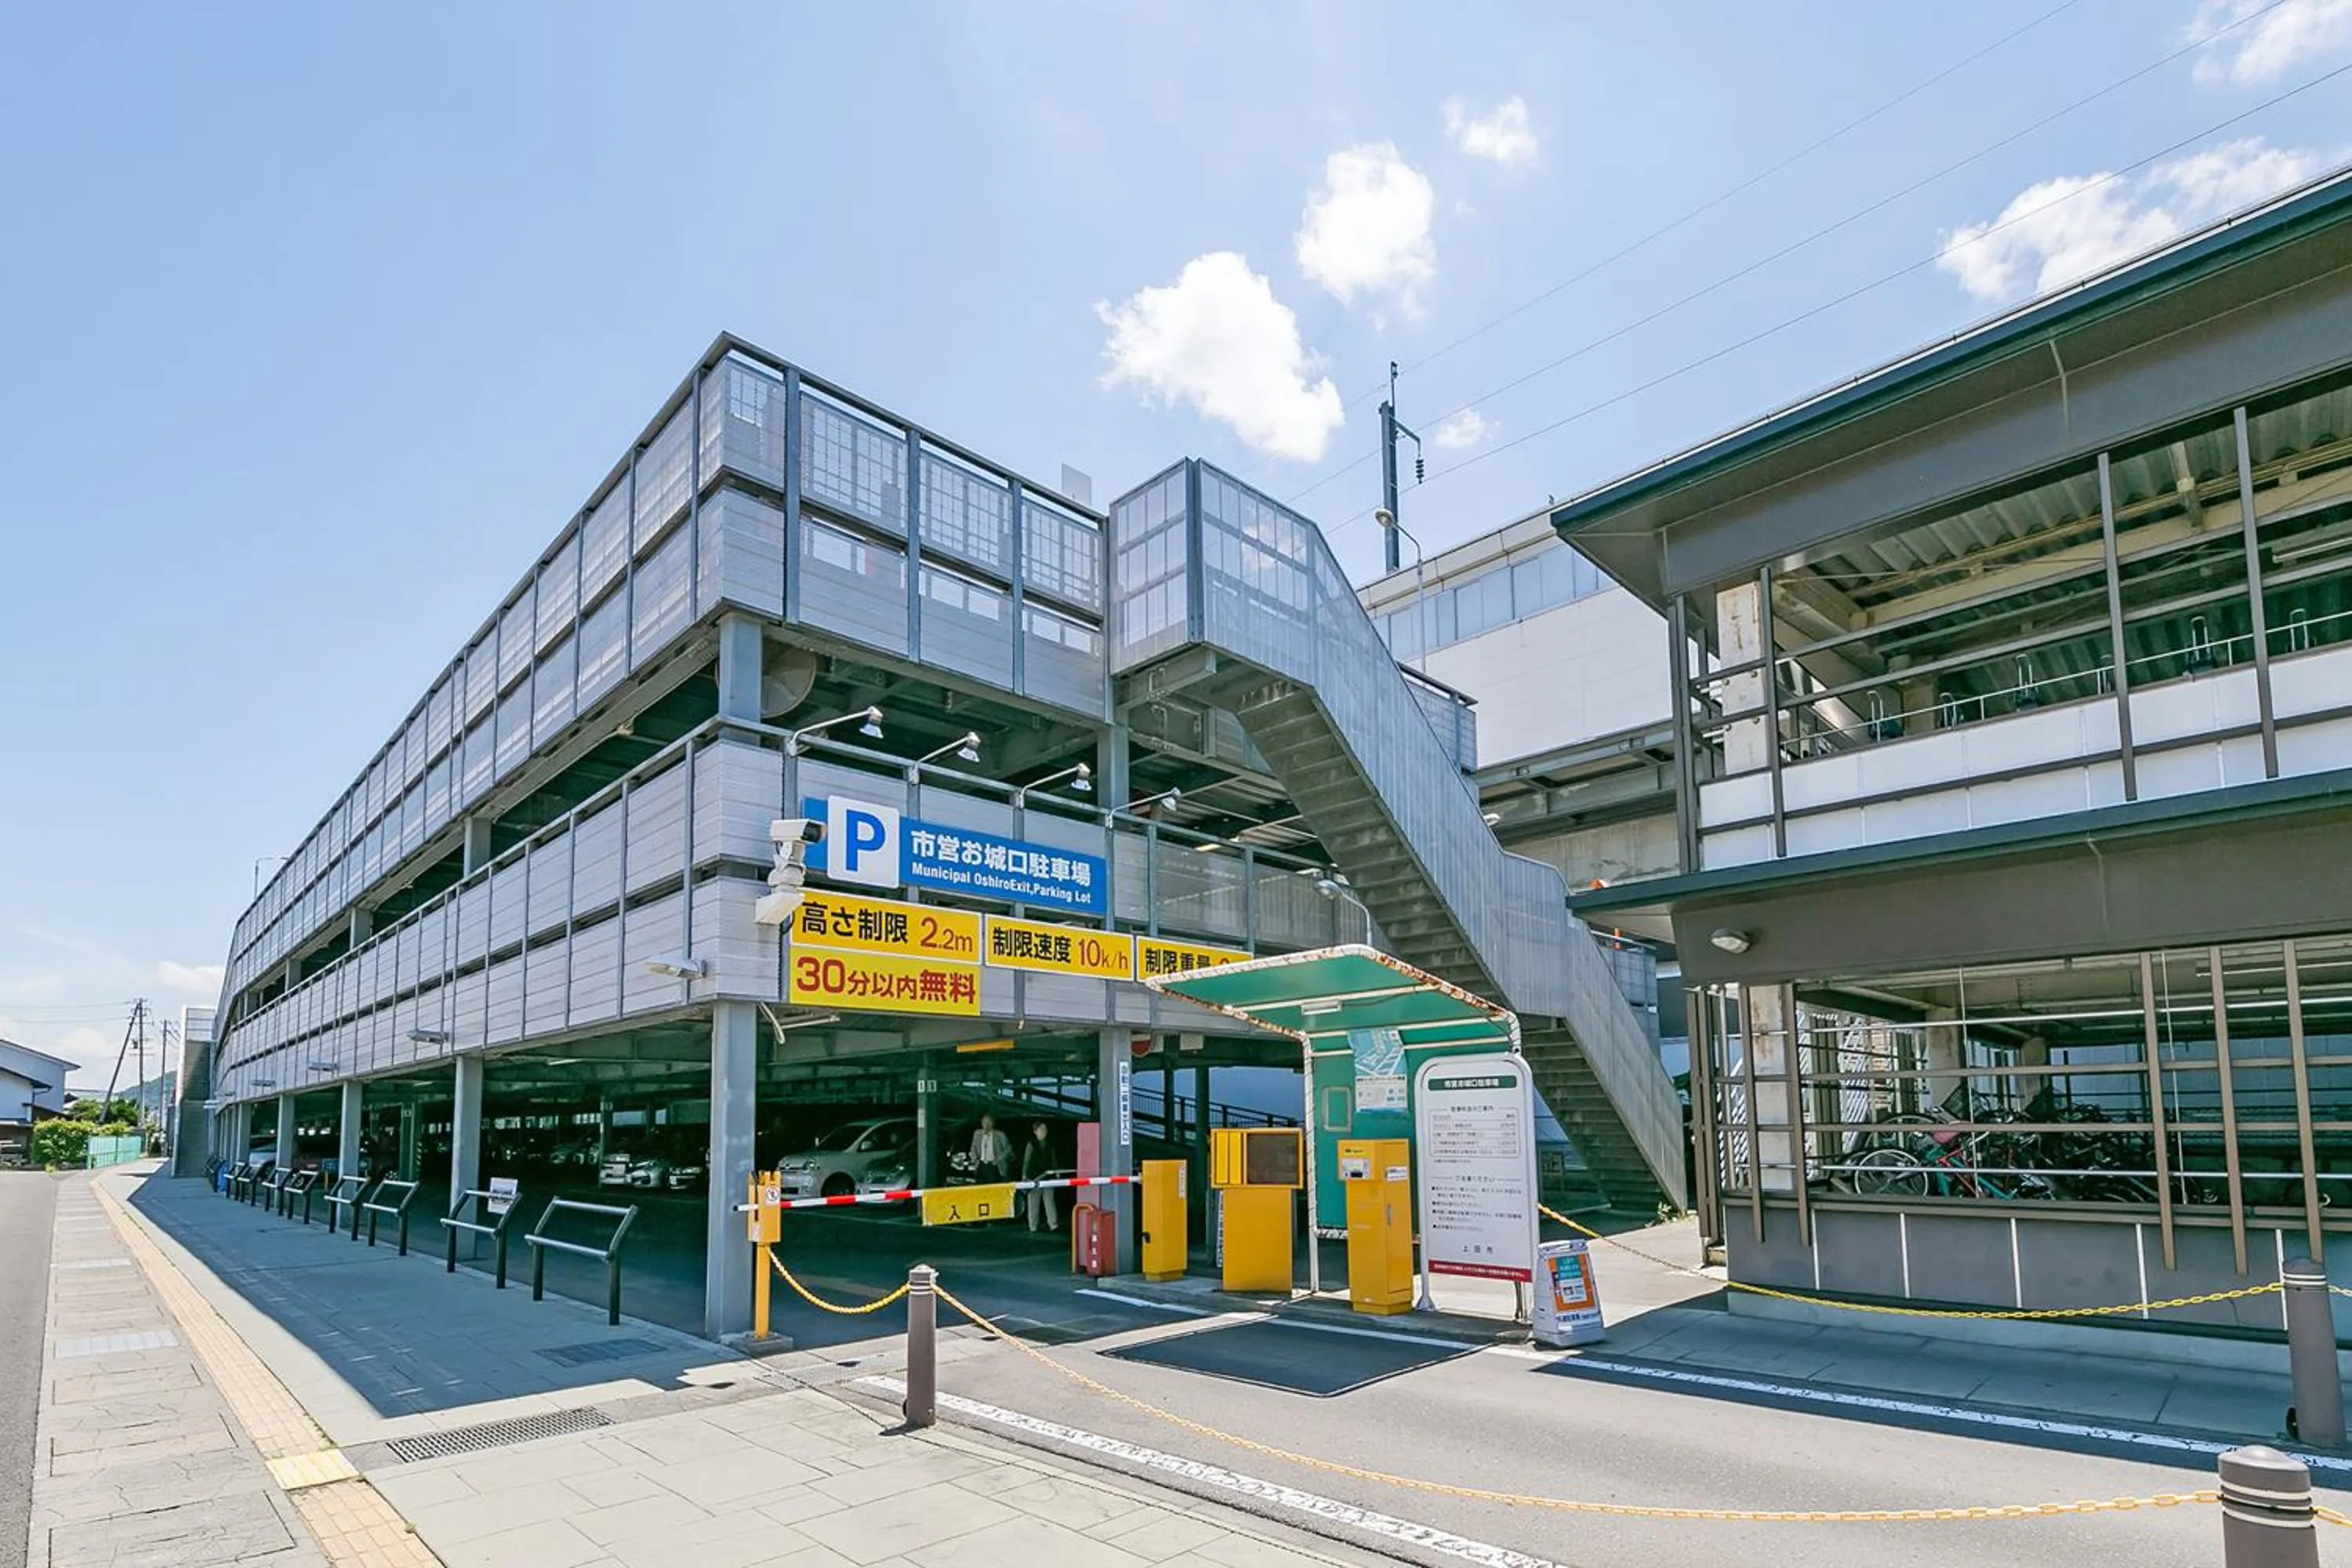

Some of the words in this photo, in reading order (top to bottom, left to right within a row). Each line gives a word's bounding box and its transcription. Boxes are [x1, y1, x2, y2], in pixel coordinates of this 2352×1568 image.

[846, 809, 886, 871] P
[910, 829, 1091, 887] 市営お城口駐車場
[912, 862, 971, 884] Municipal
[1075, 890, 1091, 904] Lot
[802, 902, 909, 944] 高さ制限
[920, 916, 973, 953] 2.2m
[993, 927, 1072, 964] 制限速度
[797, 956, 976, 1004] 30分以内無料
[948, 1203, 989, 1221] 入口
